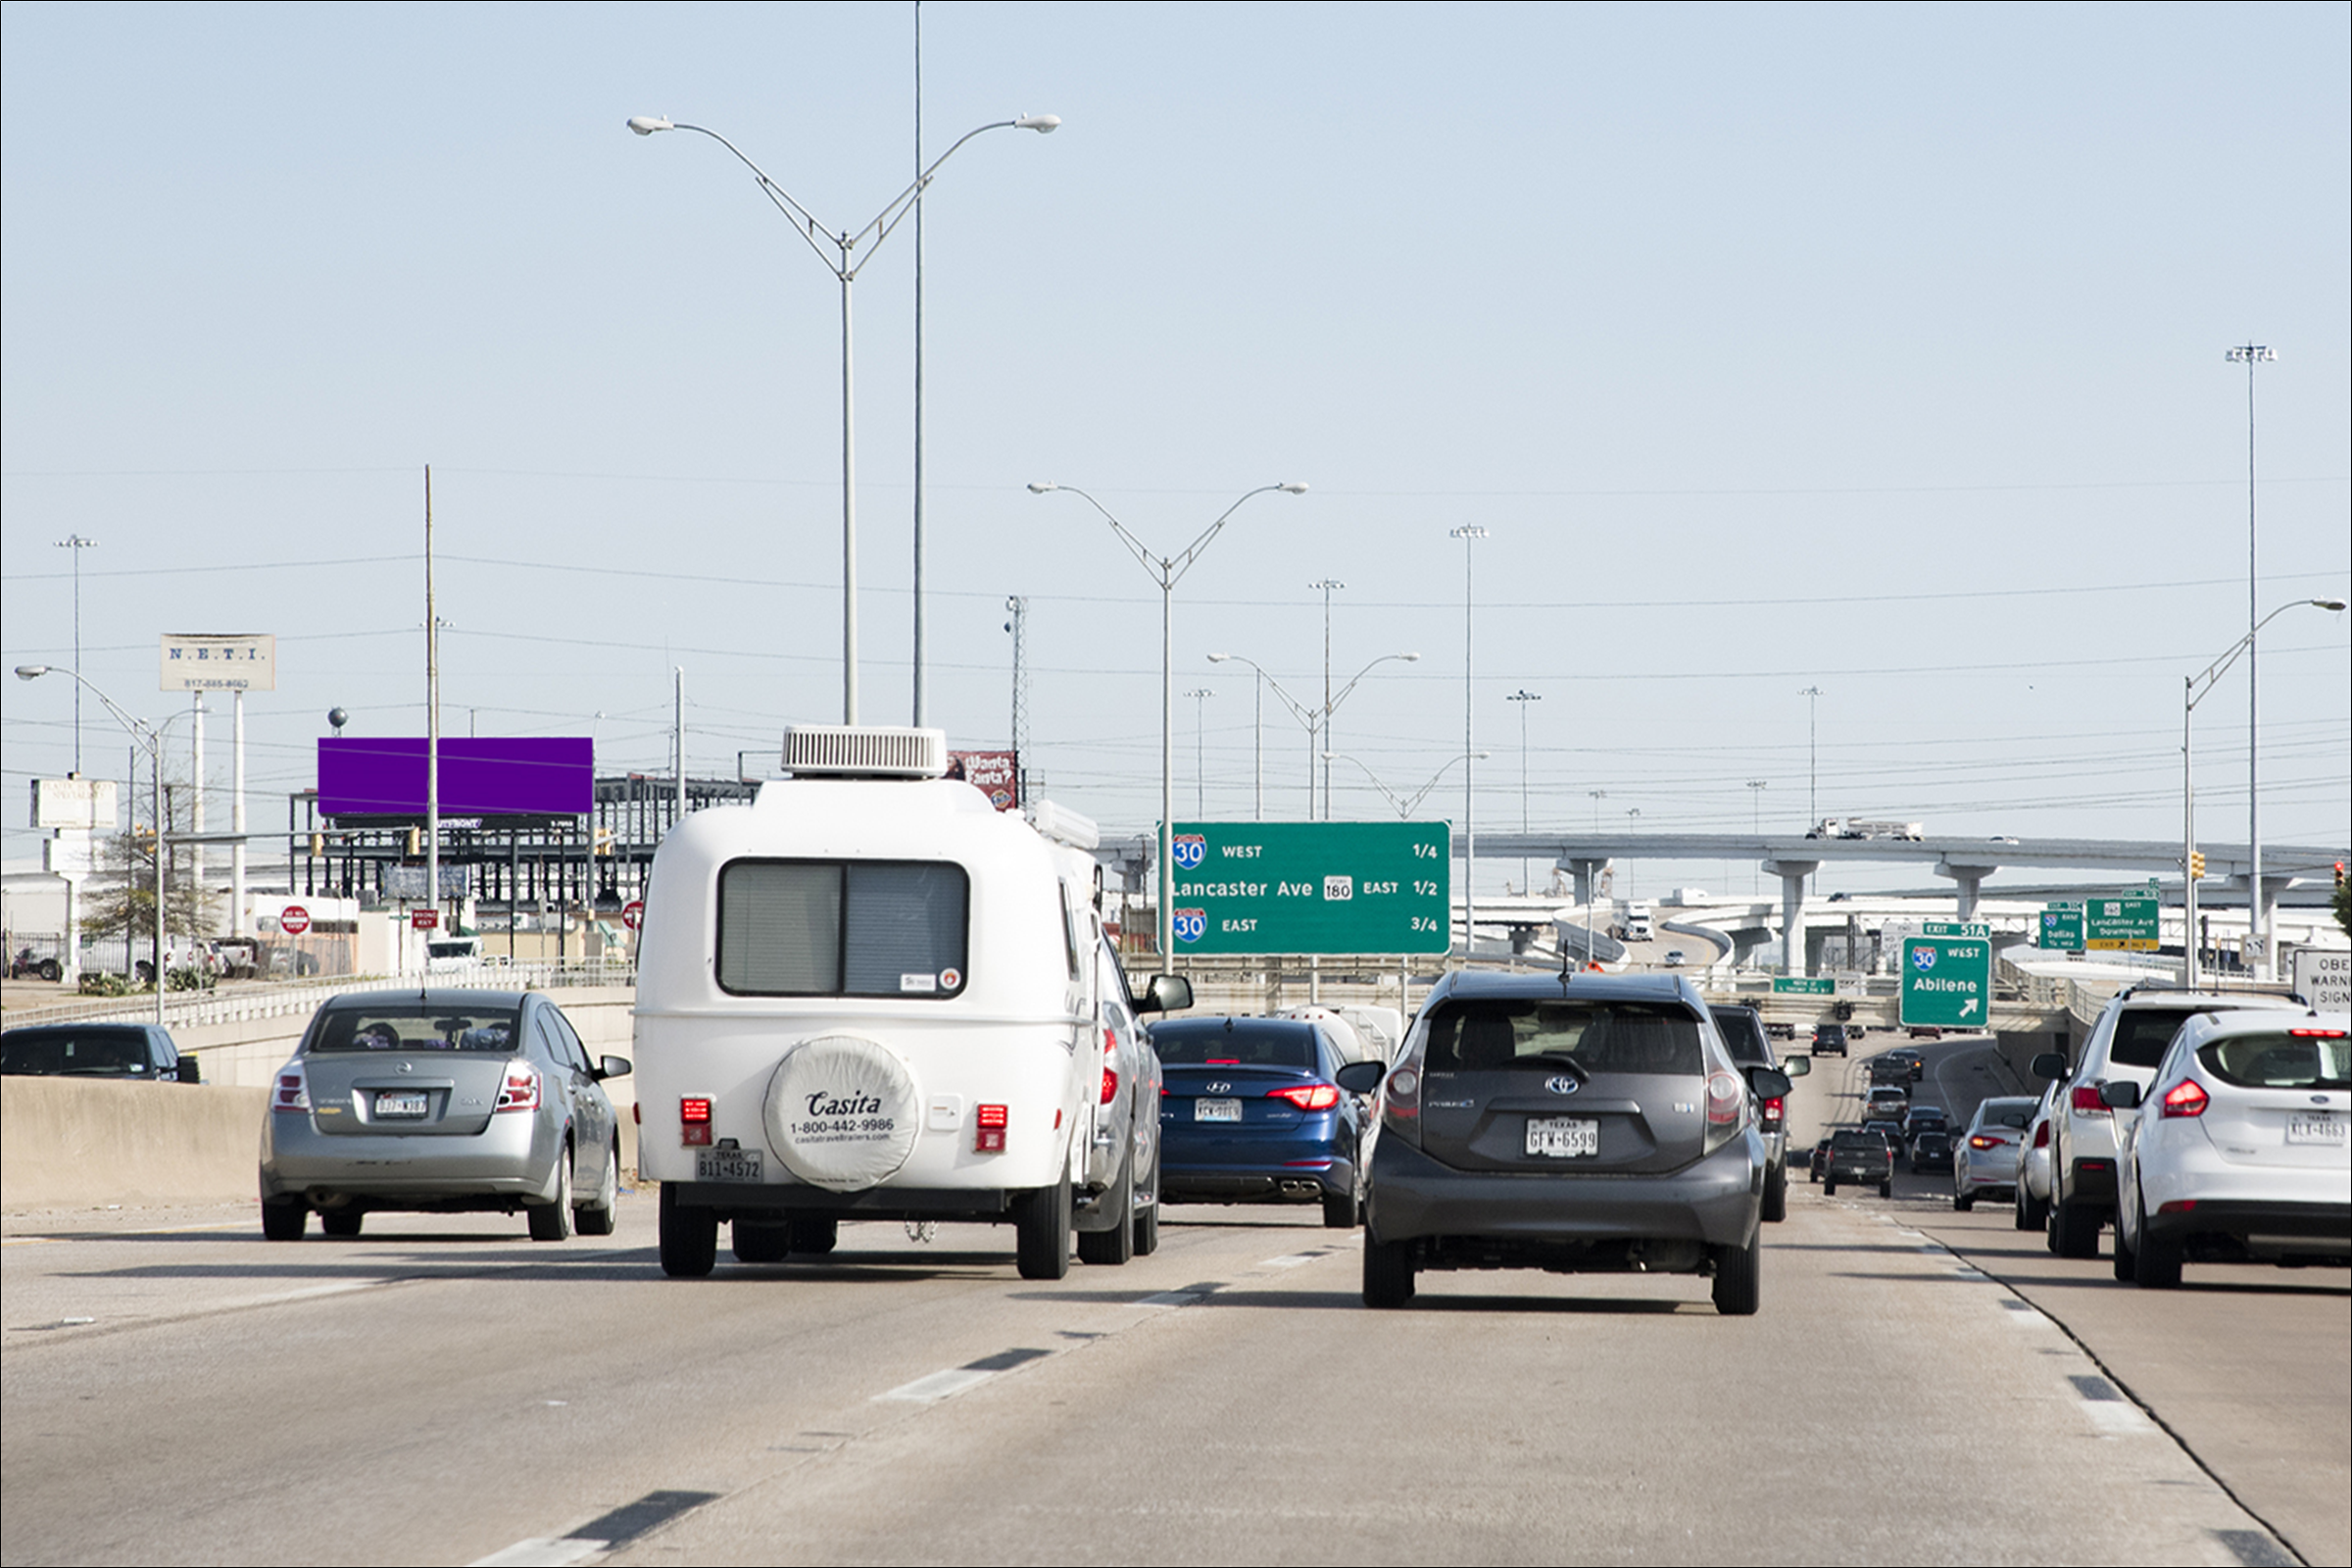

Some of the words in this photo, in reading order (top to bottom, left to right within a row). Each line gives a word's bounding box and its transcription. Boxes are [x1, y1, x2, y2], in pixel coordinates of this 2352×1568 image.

[964, 756, 1010, 770] Wanta
[964, 769, 1012, 785] Fanta?
[1176, 843, 1203, 862] 30
[1222, 846, 1263, 858] WEST
[1412, 843, 1439, 859] 1/4
[1172, 881, 1268, 897] Lancaster
[1277, 881, 1313, 897] Ave
[1326, 885, 1350, 899] 180
[1363, 882, 1399, 894] EAST
[1413, 880, 1438, 896] 1/2
[1176, 916, 1204, 936] 30
[1222, 919, 1258, 932] EAST
[1410, 916, 1439, 932] 3/4
[1961, 925, 1986, 936] 51A
[1915, 953, 1934, 967] 30
[1947, 947, 1980, 957] WEST
[1913, 977, 1978, 993] Abilene
[805, 1090, 882, 1117] Casita
[791, 1117, 895, 1134] 1-800-442-9986
